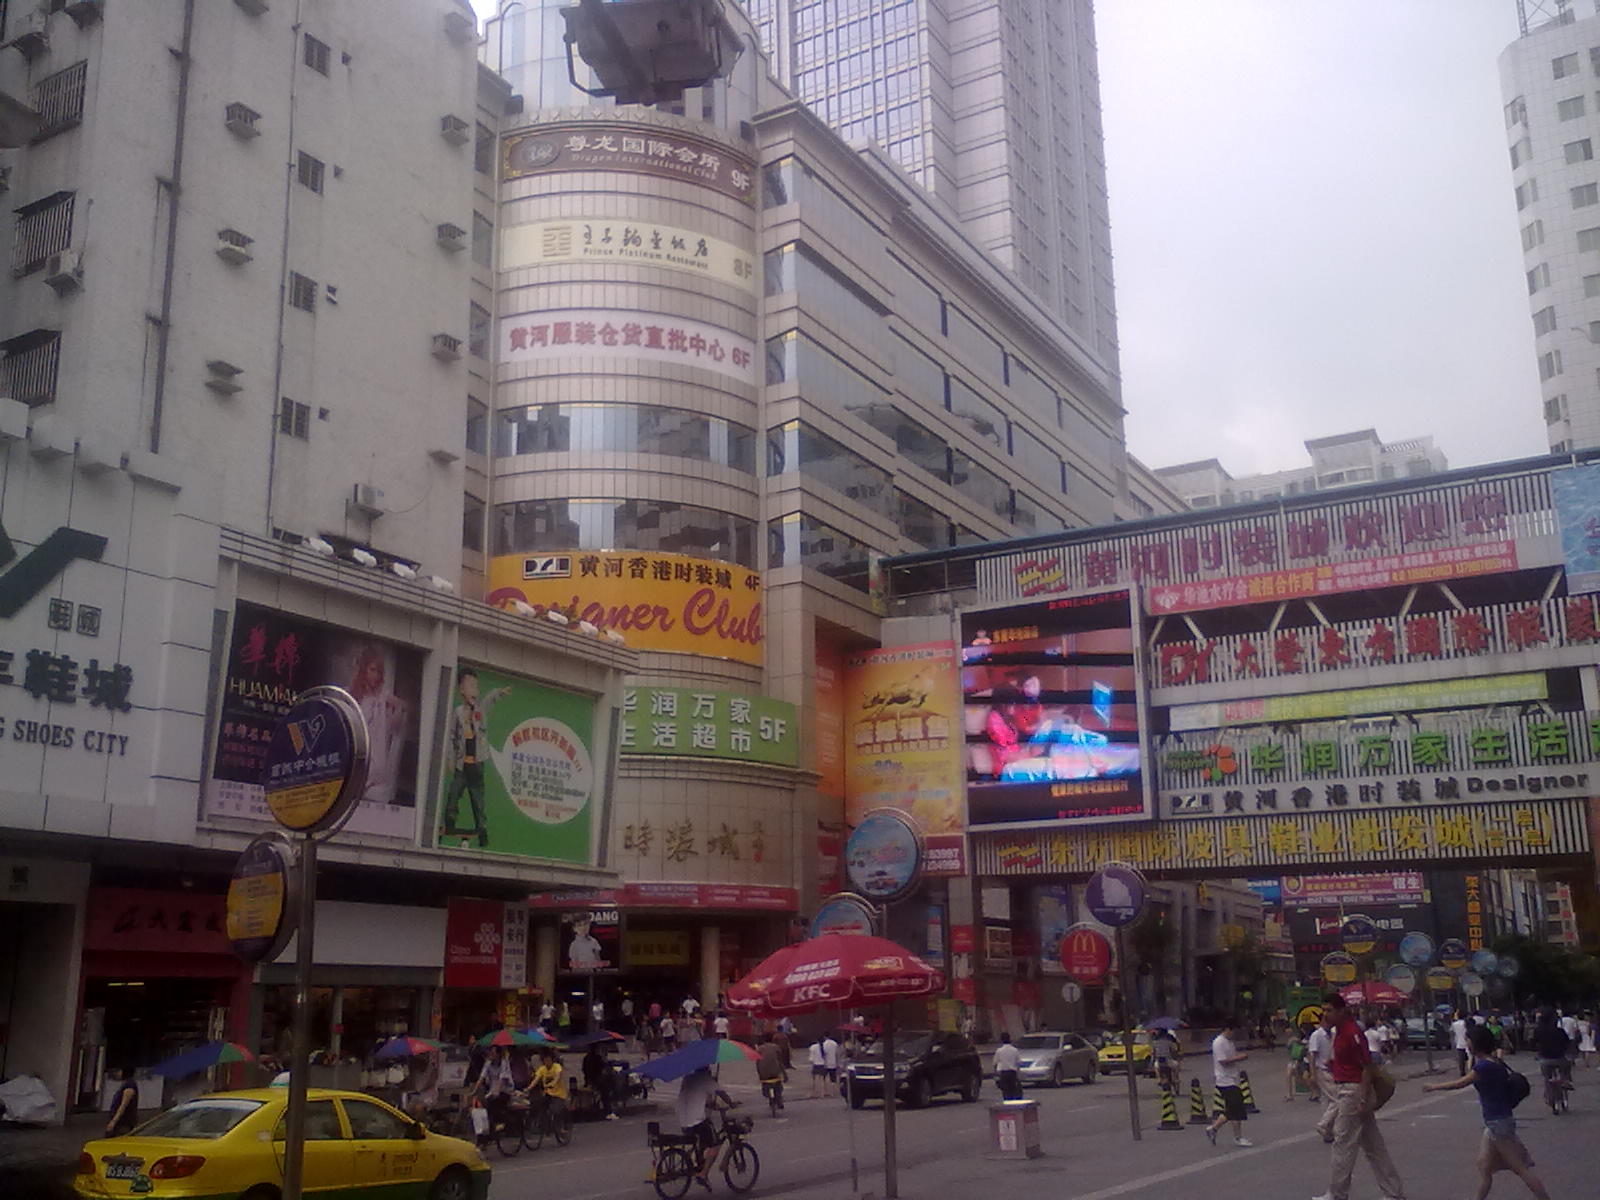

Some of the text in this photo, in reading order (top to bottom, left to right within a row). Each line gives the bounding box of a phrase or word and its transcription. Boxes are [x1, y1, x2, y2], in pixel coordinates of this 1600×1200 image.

[564, 135, 751, 191] 尊龙国际会所 9F
[733, 258, 753, 280] 8F
[732, 346, 752, 370] 6F
[578, 554, 733, 590] 黄河香港时装城
[682, 587, 765, 646] Club
[12, 718, 75, 749] SHOES
[83, 729, 129, 756] CITY
[759, 716, 787, 743] 5F
[1222, 776, 1461, 814] 黄河香港时装城
[1466, 772, 1590, 795] Designer
[792, 983, 831, 1004] KFC
